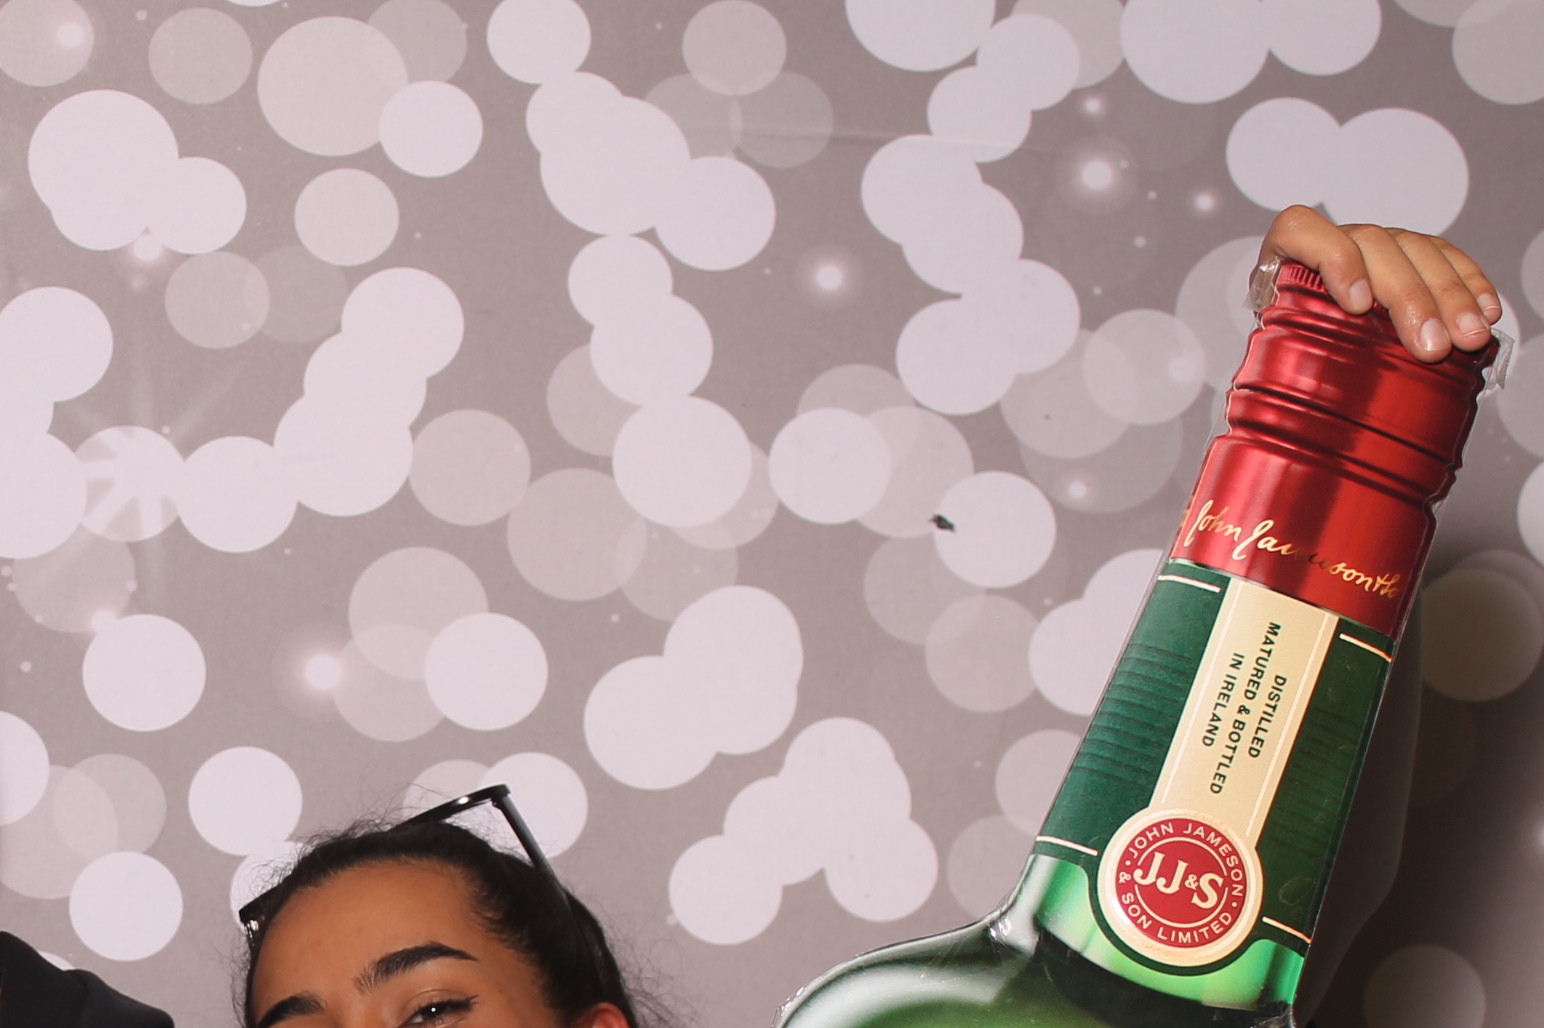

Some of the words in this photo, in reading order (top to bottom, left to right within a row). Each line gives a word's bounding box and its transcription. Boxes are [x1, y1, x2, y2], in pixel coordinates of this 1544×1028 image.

[1184, 499, 1242, 547] John
[1228, 652, 1245, 671] IN
[1243, 621, 1282, 701] MATURED
[1201, 674, 1238, 747] IRELAND
[1236, 704, 1251, 716] &
[1247, 674, 1287, 758] DISTILLED
[1209, 719, 1247, 795] BOTTLED
[1128, 822, 1174, 859] JOHN
[1183, 823, 1244, 897] JAMESON
[1133, 851, 1224, 910] JJ&S
[1121, 892, 1153, 930] SON
[1157, 911, 1233, 944] LIMITED
